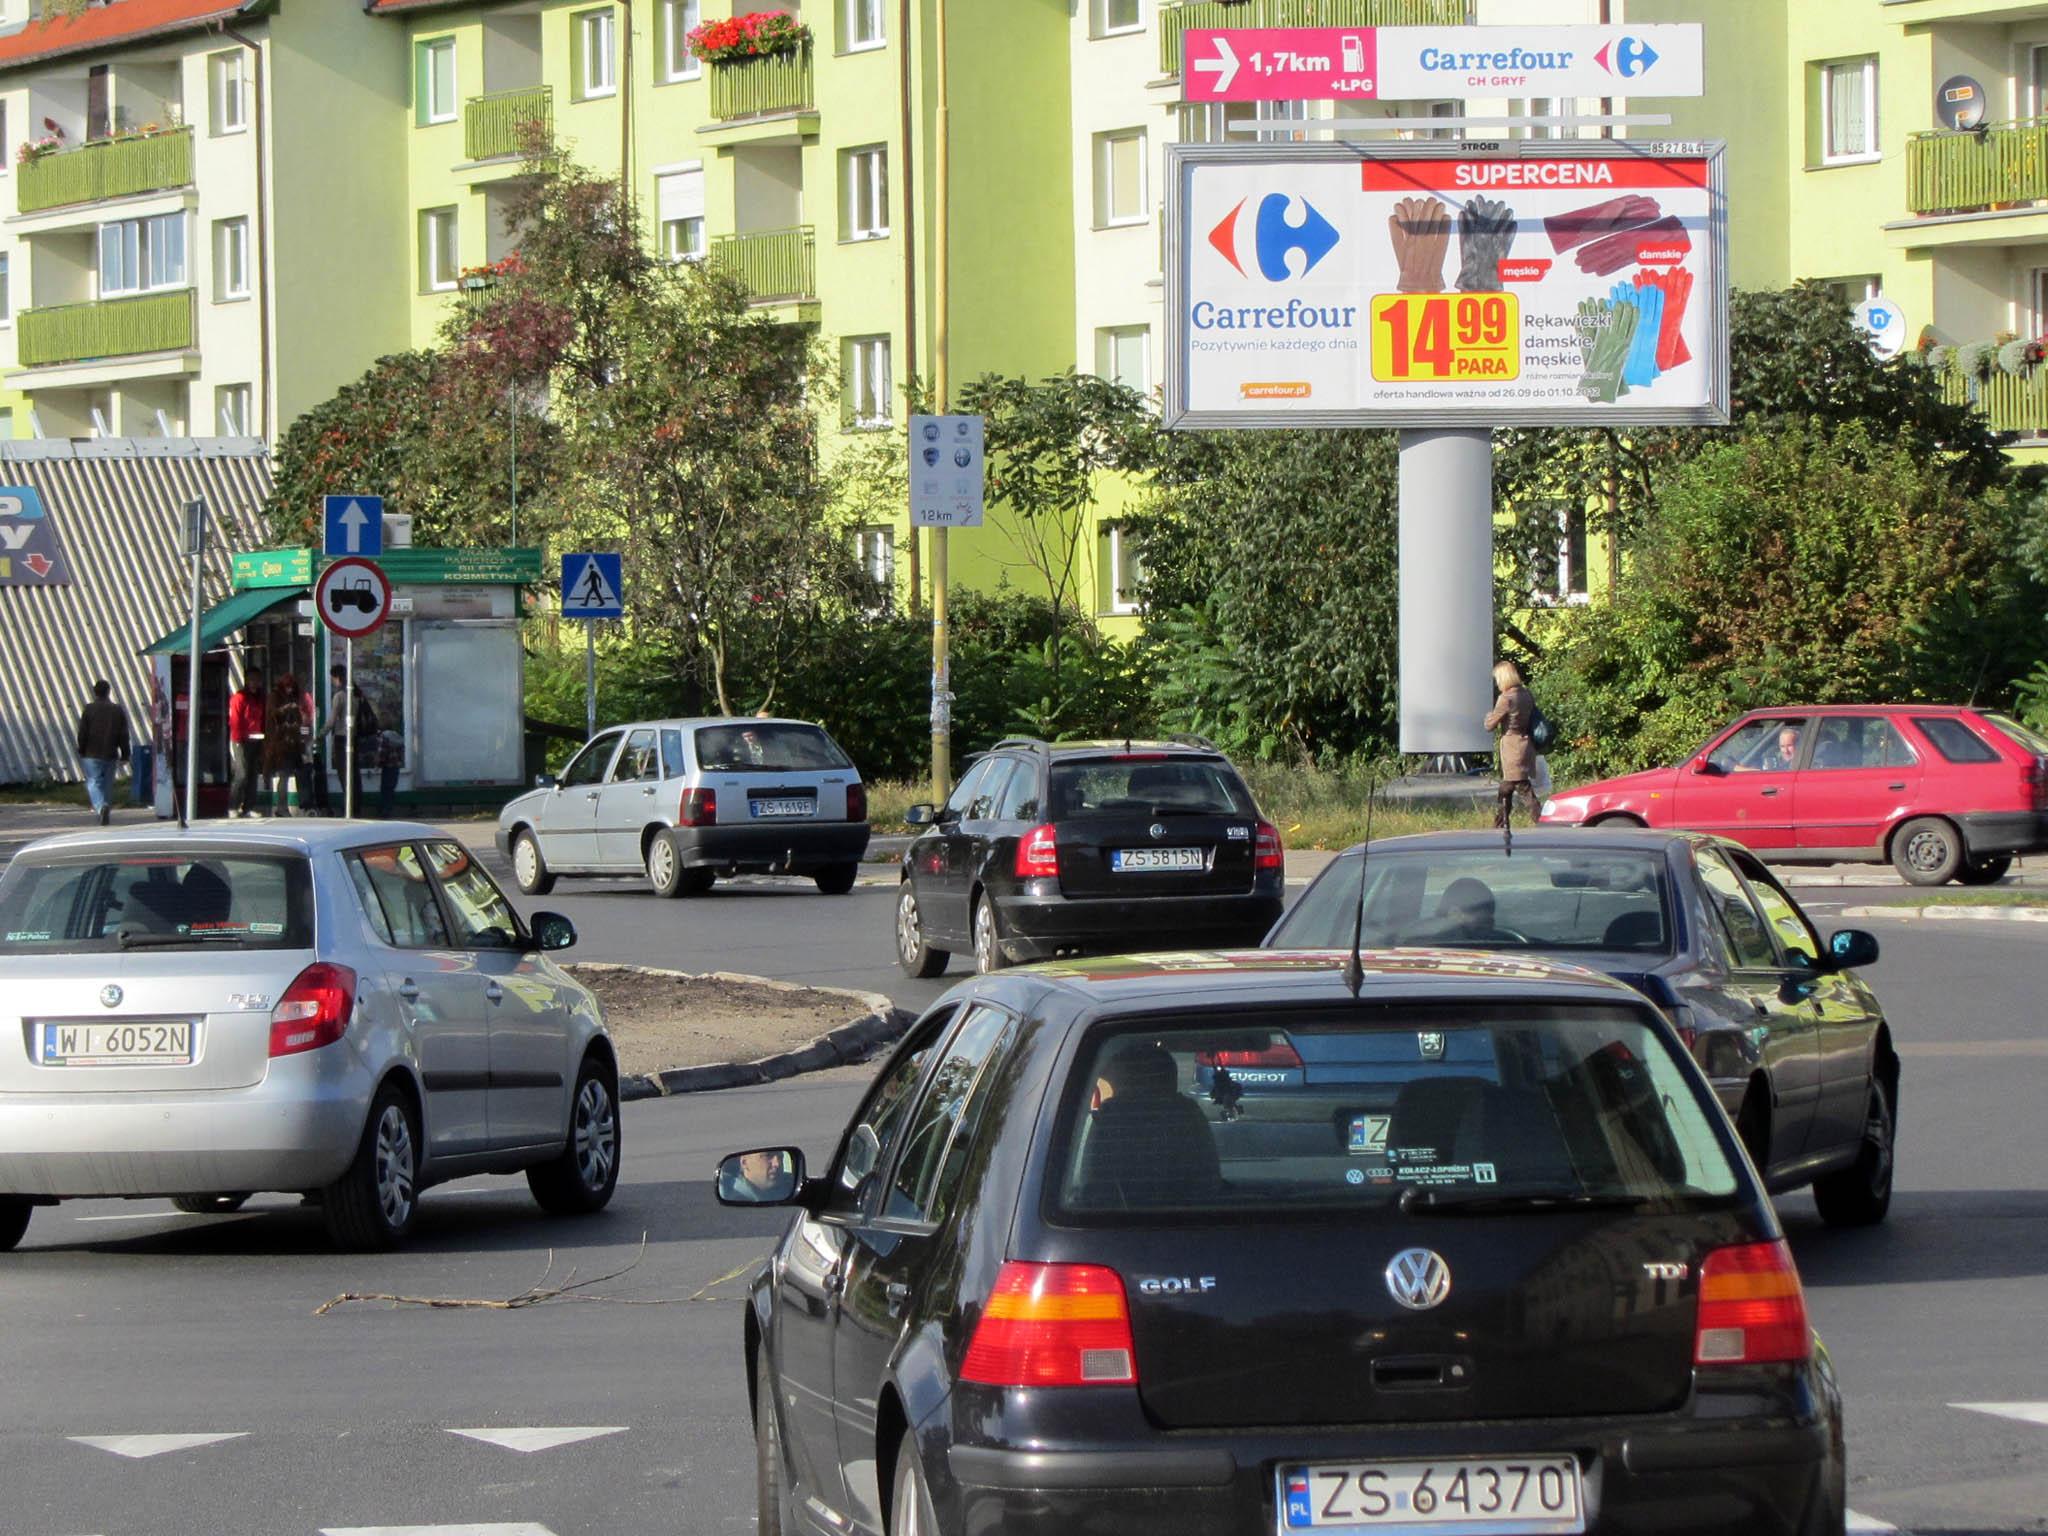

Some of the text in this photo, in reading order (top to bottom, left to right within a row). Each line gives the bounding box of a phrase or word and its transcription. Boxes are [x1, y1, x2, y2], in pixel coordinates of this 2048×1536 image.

[1249, 52, 1330, 76] 1,7km
[1420, 48, 1573, 70] Carrefour
[1331, 79, 1373, 92] +LPG
[1468, 76, 1527, 87] CH GRYF
[1455, 163, 1613, 186] SUPERCENA
[1639, 249, 1682, 260] damskie
[1503, 267, 1540, 278] męskie
[1192, 299, 1356, 330] Carrefour
[1524, 314, 1612, 330] Rękawiczki
[1191, 338, 1357, 352] Pozytywnie każdego dnia
[1379, 298, 1506, 377] 14 99
[1457, 358, 1508, 374] PARA
[1524, 352, 1582, 368] męskie
[1248, 386, 1306, 396] carrefour.pl
[1373, 390, 1405, 399] oferta
[1406, 389, 1453, 399] handlowa
[1455, 389, 1487, 398] ważna
[1488, 388, 1501, 397] od
[1532, 388, 1547, 397] do
[921, 510, 953, 521] 12 km
[1123, 849, 1200, 866] ZS 5815N
[61, 1027, 186, 1053] WI 6052N
[1227, 1072, 1288, 1082] EUGEOT
[1139, 1276, 1217, 1295] GOLF
[1317, 1464, 1565, 1519] ZS 64370
[1290, 1503, 1309, 1517] PL
